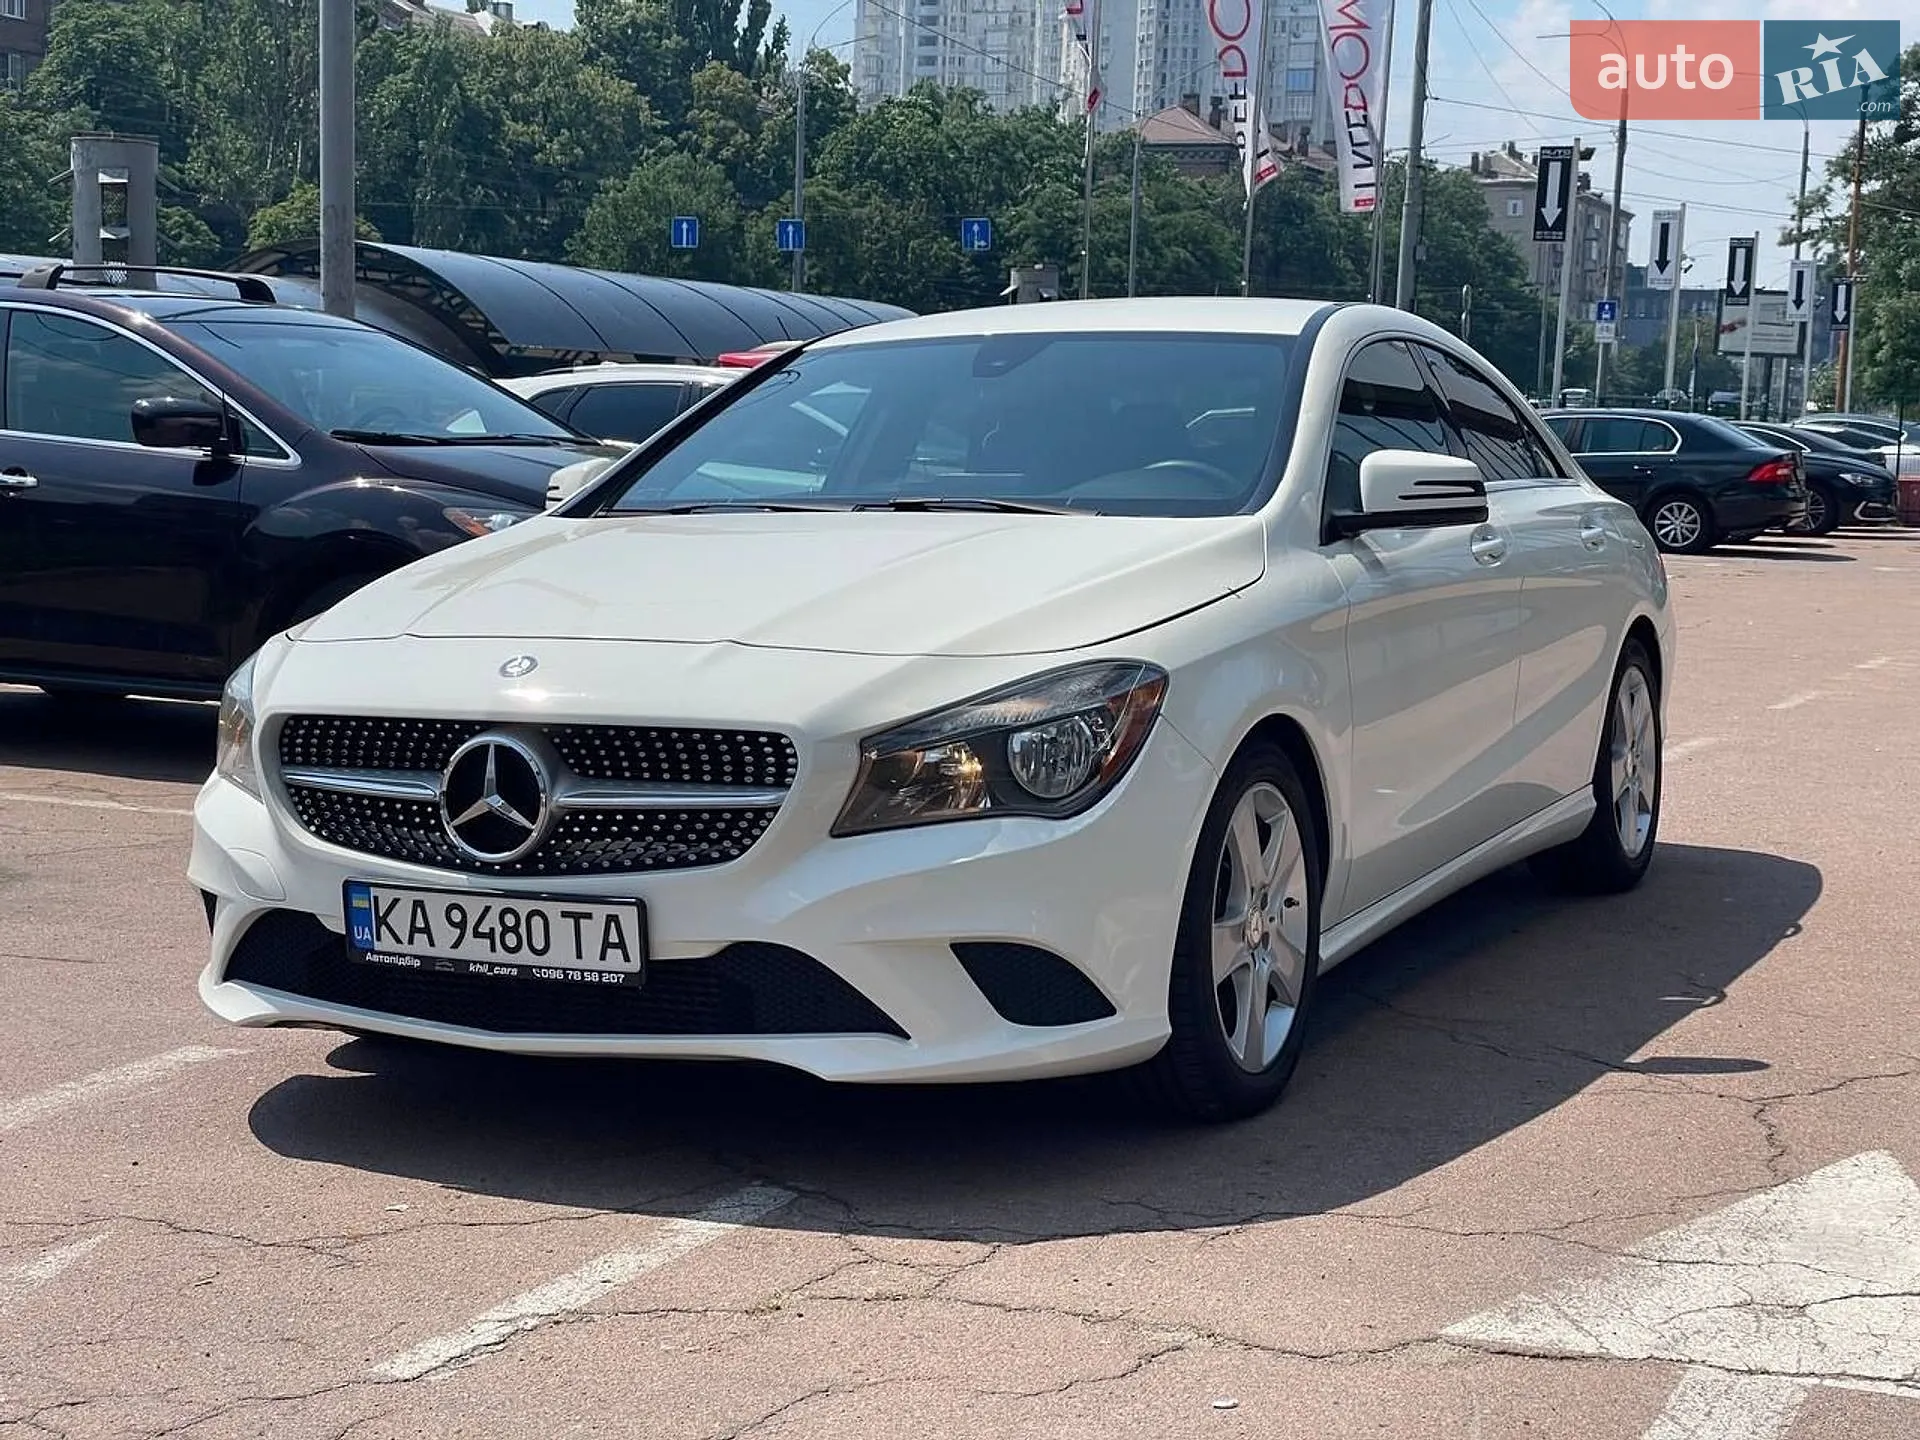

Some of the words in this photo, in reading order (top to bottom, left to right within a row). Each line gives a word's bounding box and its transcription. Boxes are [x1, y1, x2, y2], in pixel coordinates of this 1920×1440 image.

[353, 925, 372, 941] UA
[444, 903, 551, 956] 9480
[541, 968, 564, 979] 096
[583, 972, 599, 982] 58
[601, 973, 625, 983] 207
